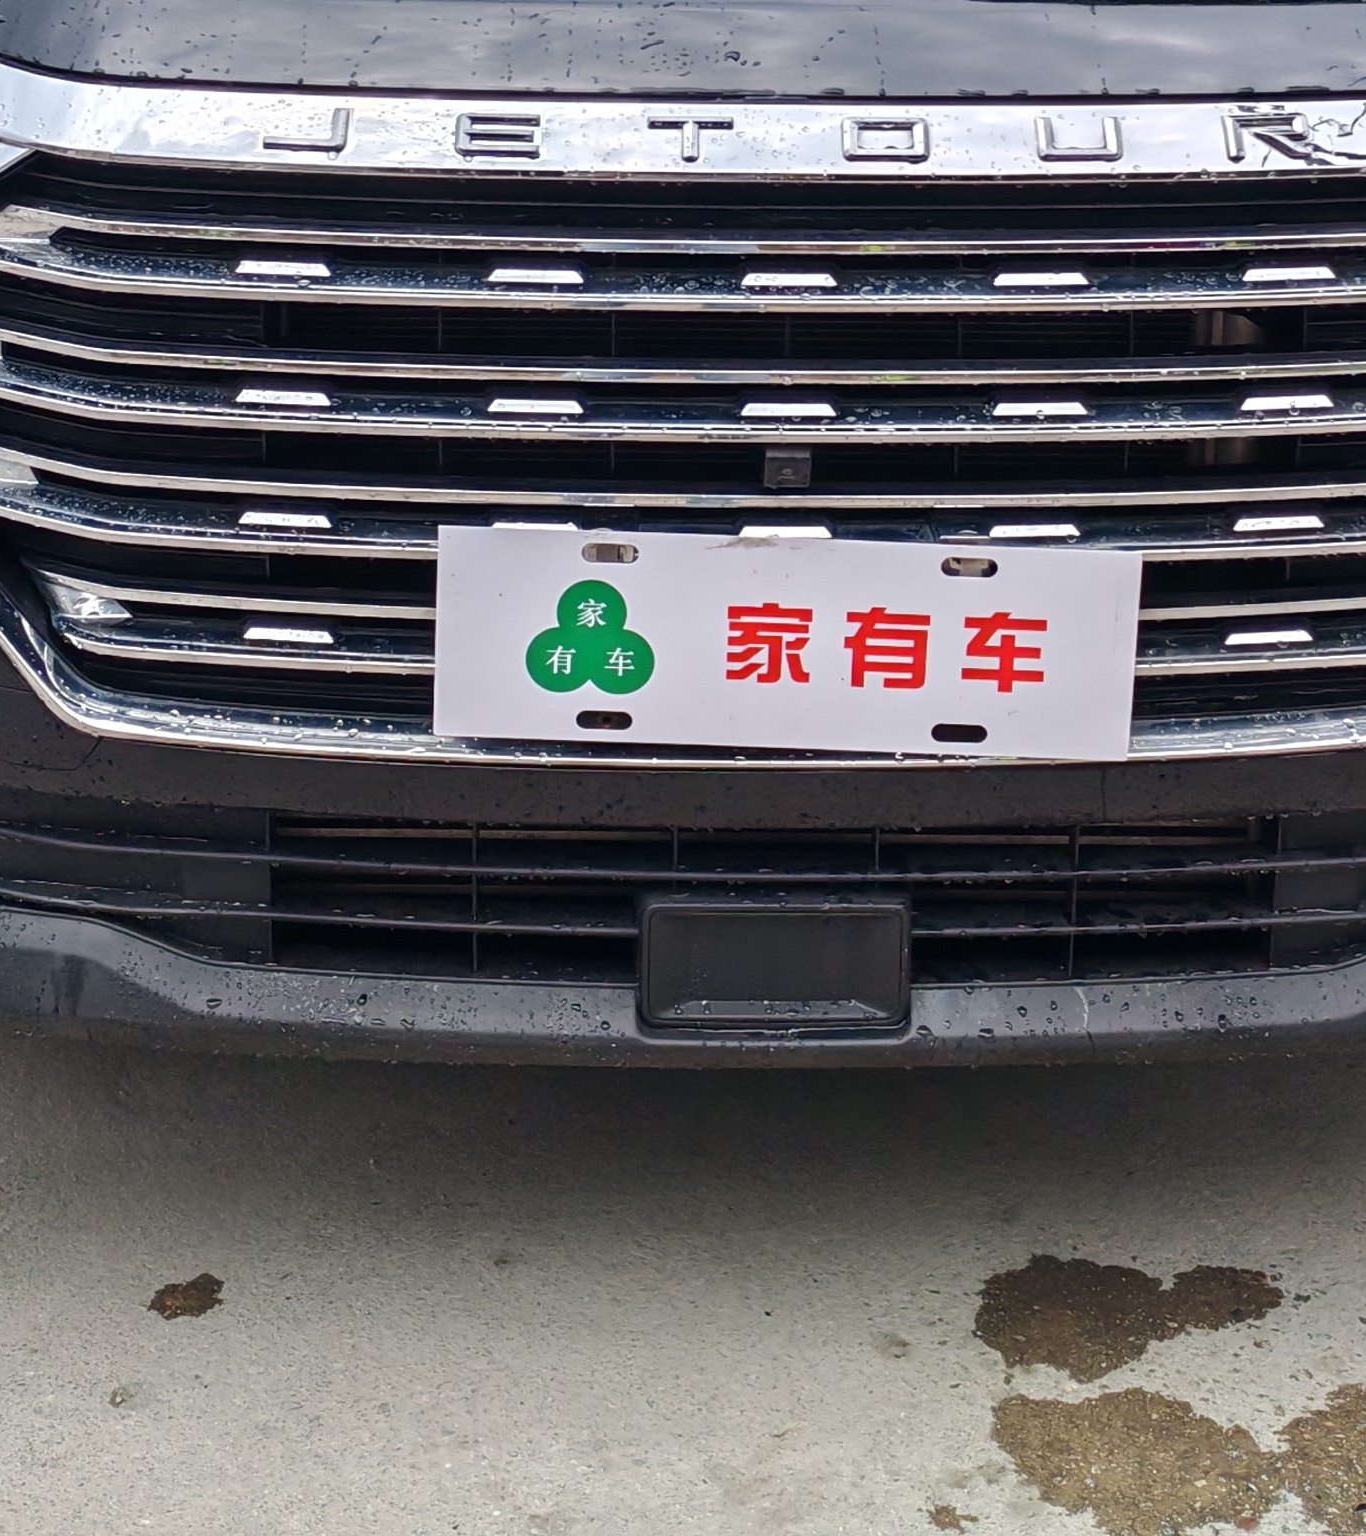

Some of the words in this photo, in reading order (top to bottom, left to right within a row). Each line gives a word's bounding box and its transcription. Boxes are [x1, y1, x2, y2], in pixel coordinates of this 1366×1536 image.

[262, 107, 1313, 163] JETOUR
[576, 598, 607, 628] 家
[725, 602, 1048, 693] 家有车
